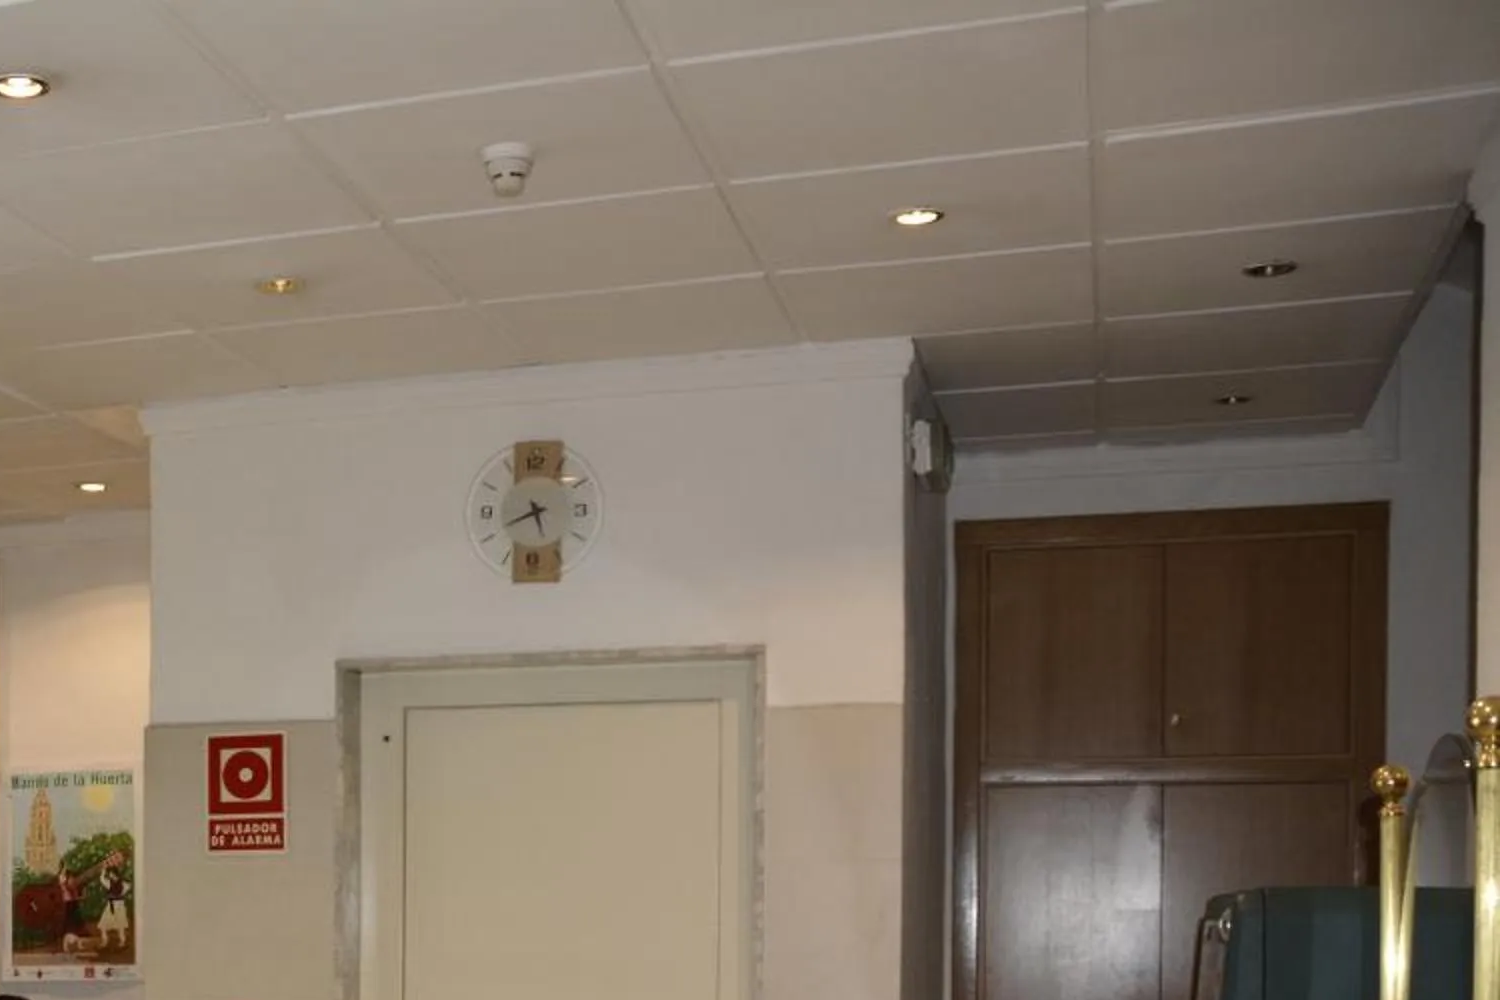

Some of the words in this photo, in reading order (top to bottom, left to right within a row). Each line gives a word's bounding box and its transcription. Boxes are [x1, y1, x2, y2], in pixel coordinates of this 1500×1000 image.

[526, 456, 545, 471] 12
[54, 771, 68, 787] de
[73, 772, 85, 786] la
[91, 770, 132, 786] Huerta
[214, 822, 277, 835] PULSADOR
[211, 834, 226, 847] DE
[231, 834, 281, 846] ALARMA
